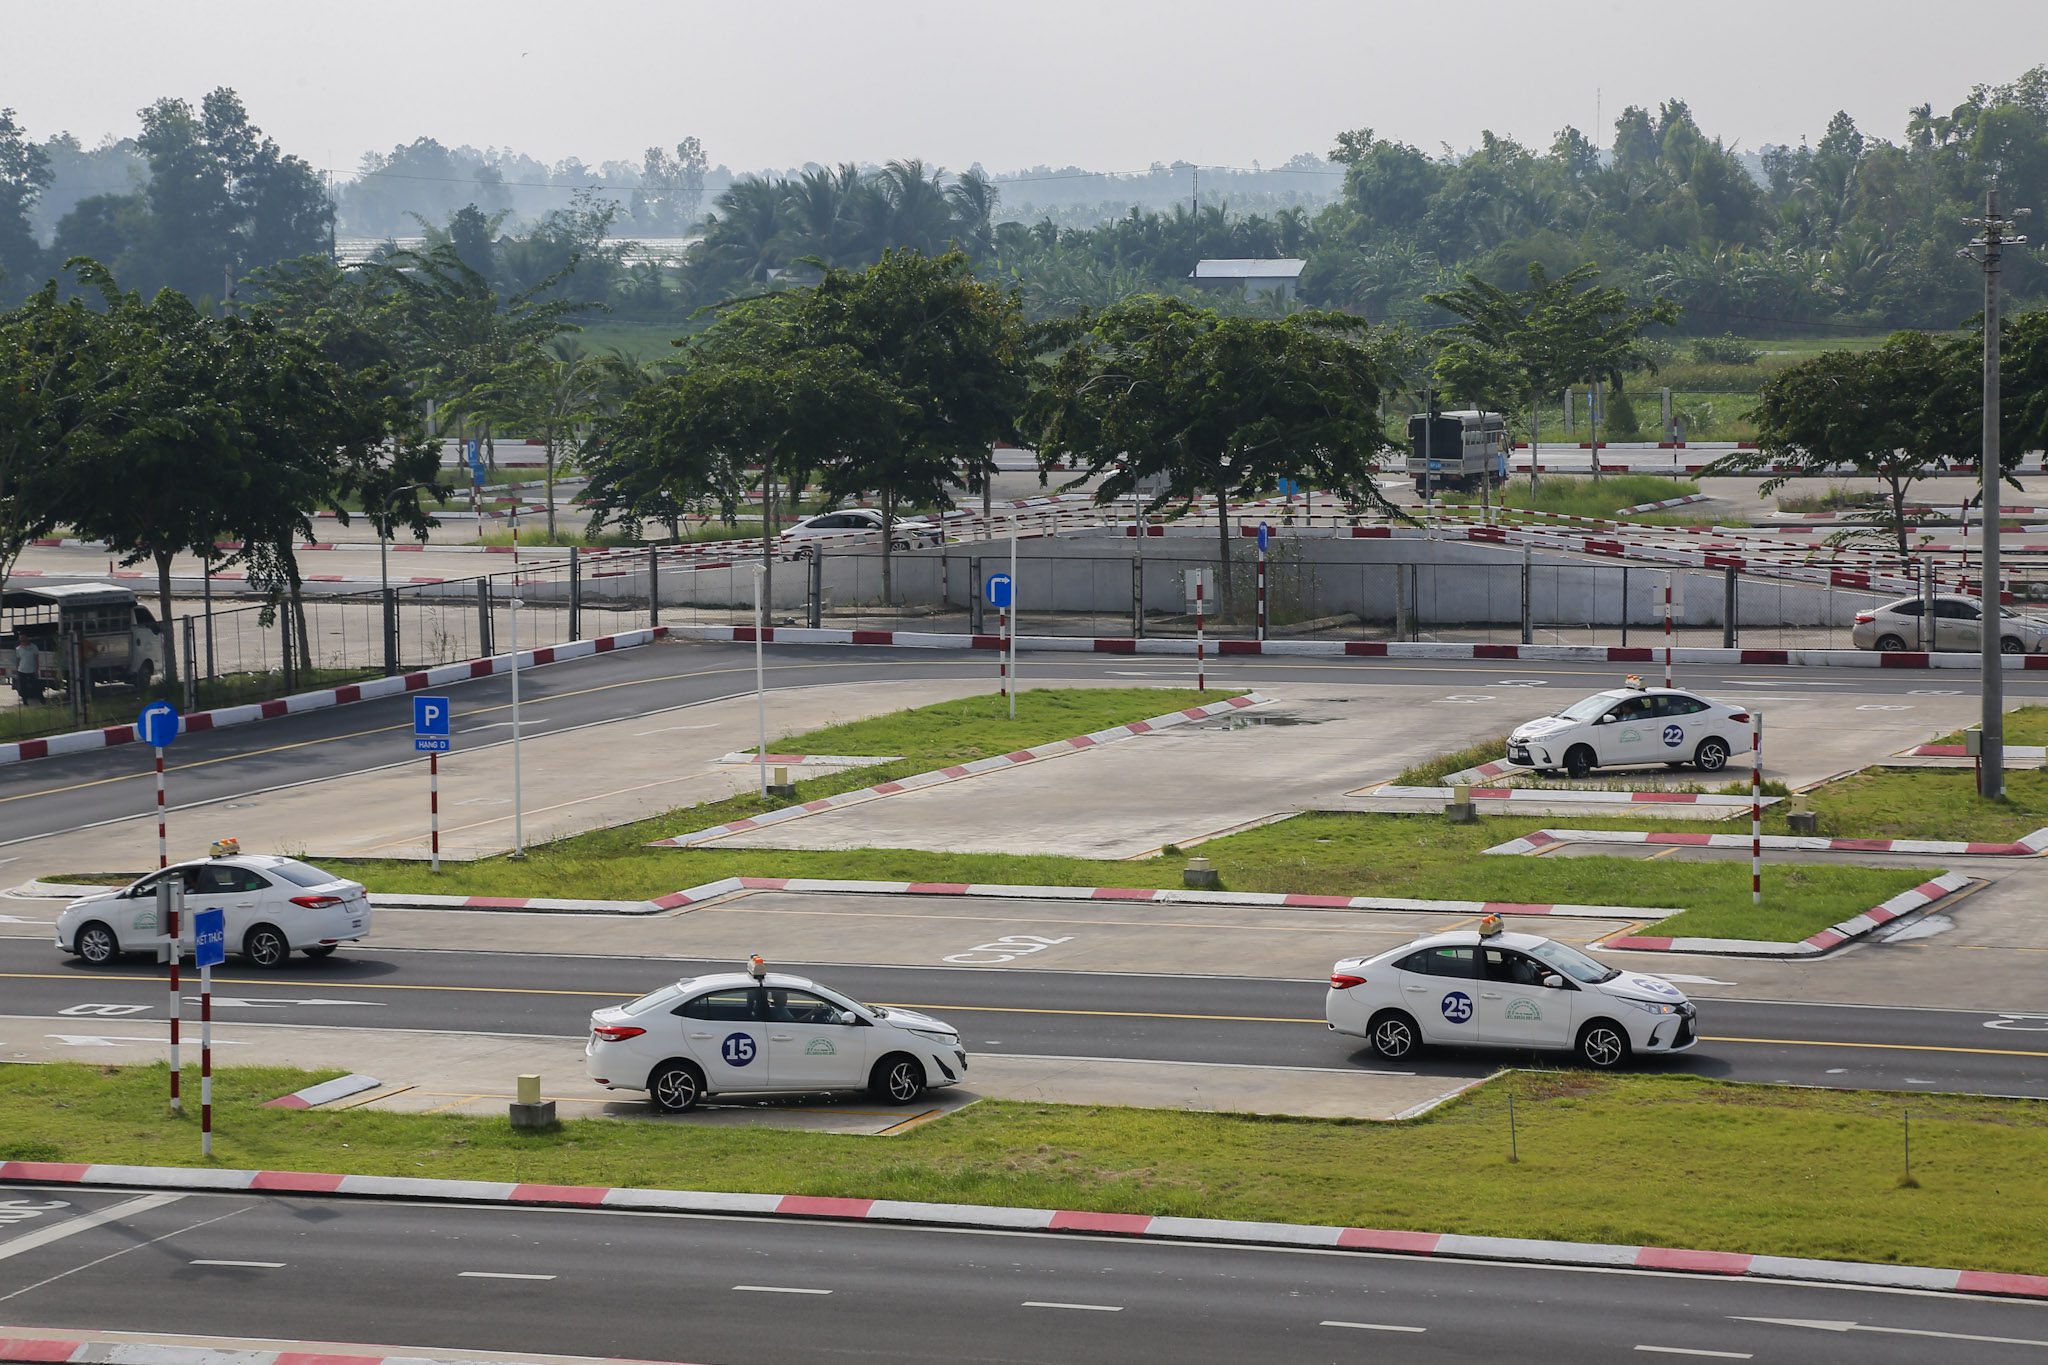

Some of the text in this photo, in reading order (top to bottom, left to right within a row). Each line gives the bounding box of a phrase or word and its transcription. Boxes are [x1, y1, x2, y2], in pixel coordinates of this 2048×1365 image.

[469, 441, 476, 458] P
[424, 704, 440, 727] P
[1664, 728, 1682, 743] 22
[1443, 996, 1471, 1019] 25
[726, 1038, 753, 1060] 15
